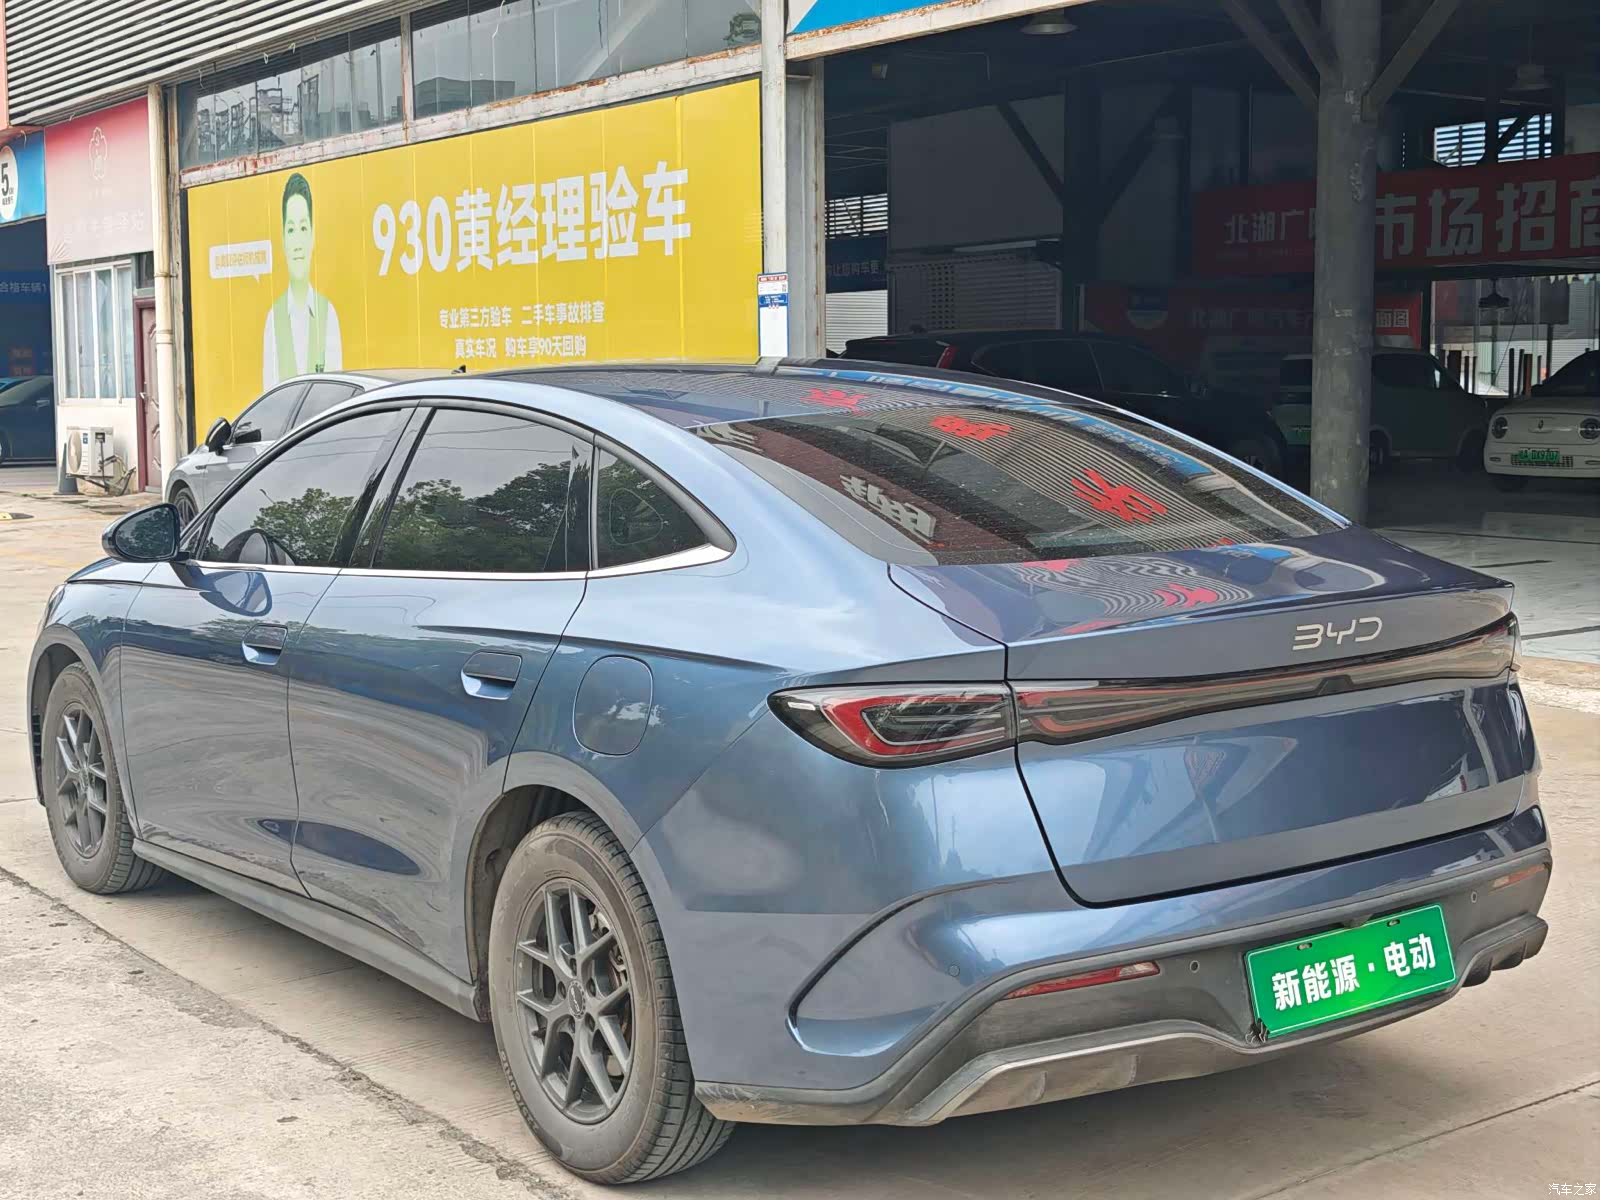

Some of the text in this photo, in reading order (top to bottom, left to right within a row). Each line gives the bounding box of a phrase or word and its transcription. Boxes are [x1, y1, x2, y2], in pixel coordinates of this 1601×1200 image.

[373, 160, 691, 276] 930黄经理验车
[1223, 206, 1316, 245] 北湖广
[439, 300, 605, 329] 专业第三方验车 二手车事故排查
[454, 334, 587, 359] 真实车况 购车享90天回购
[1292, 616, 1383, 651] BYD
